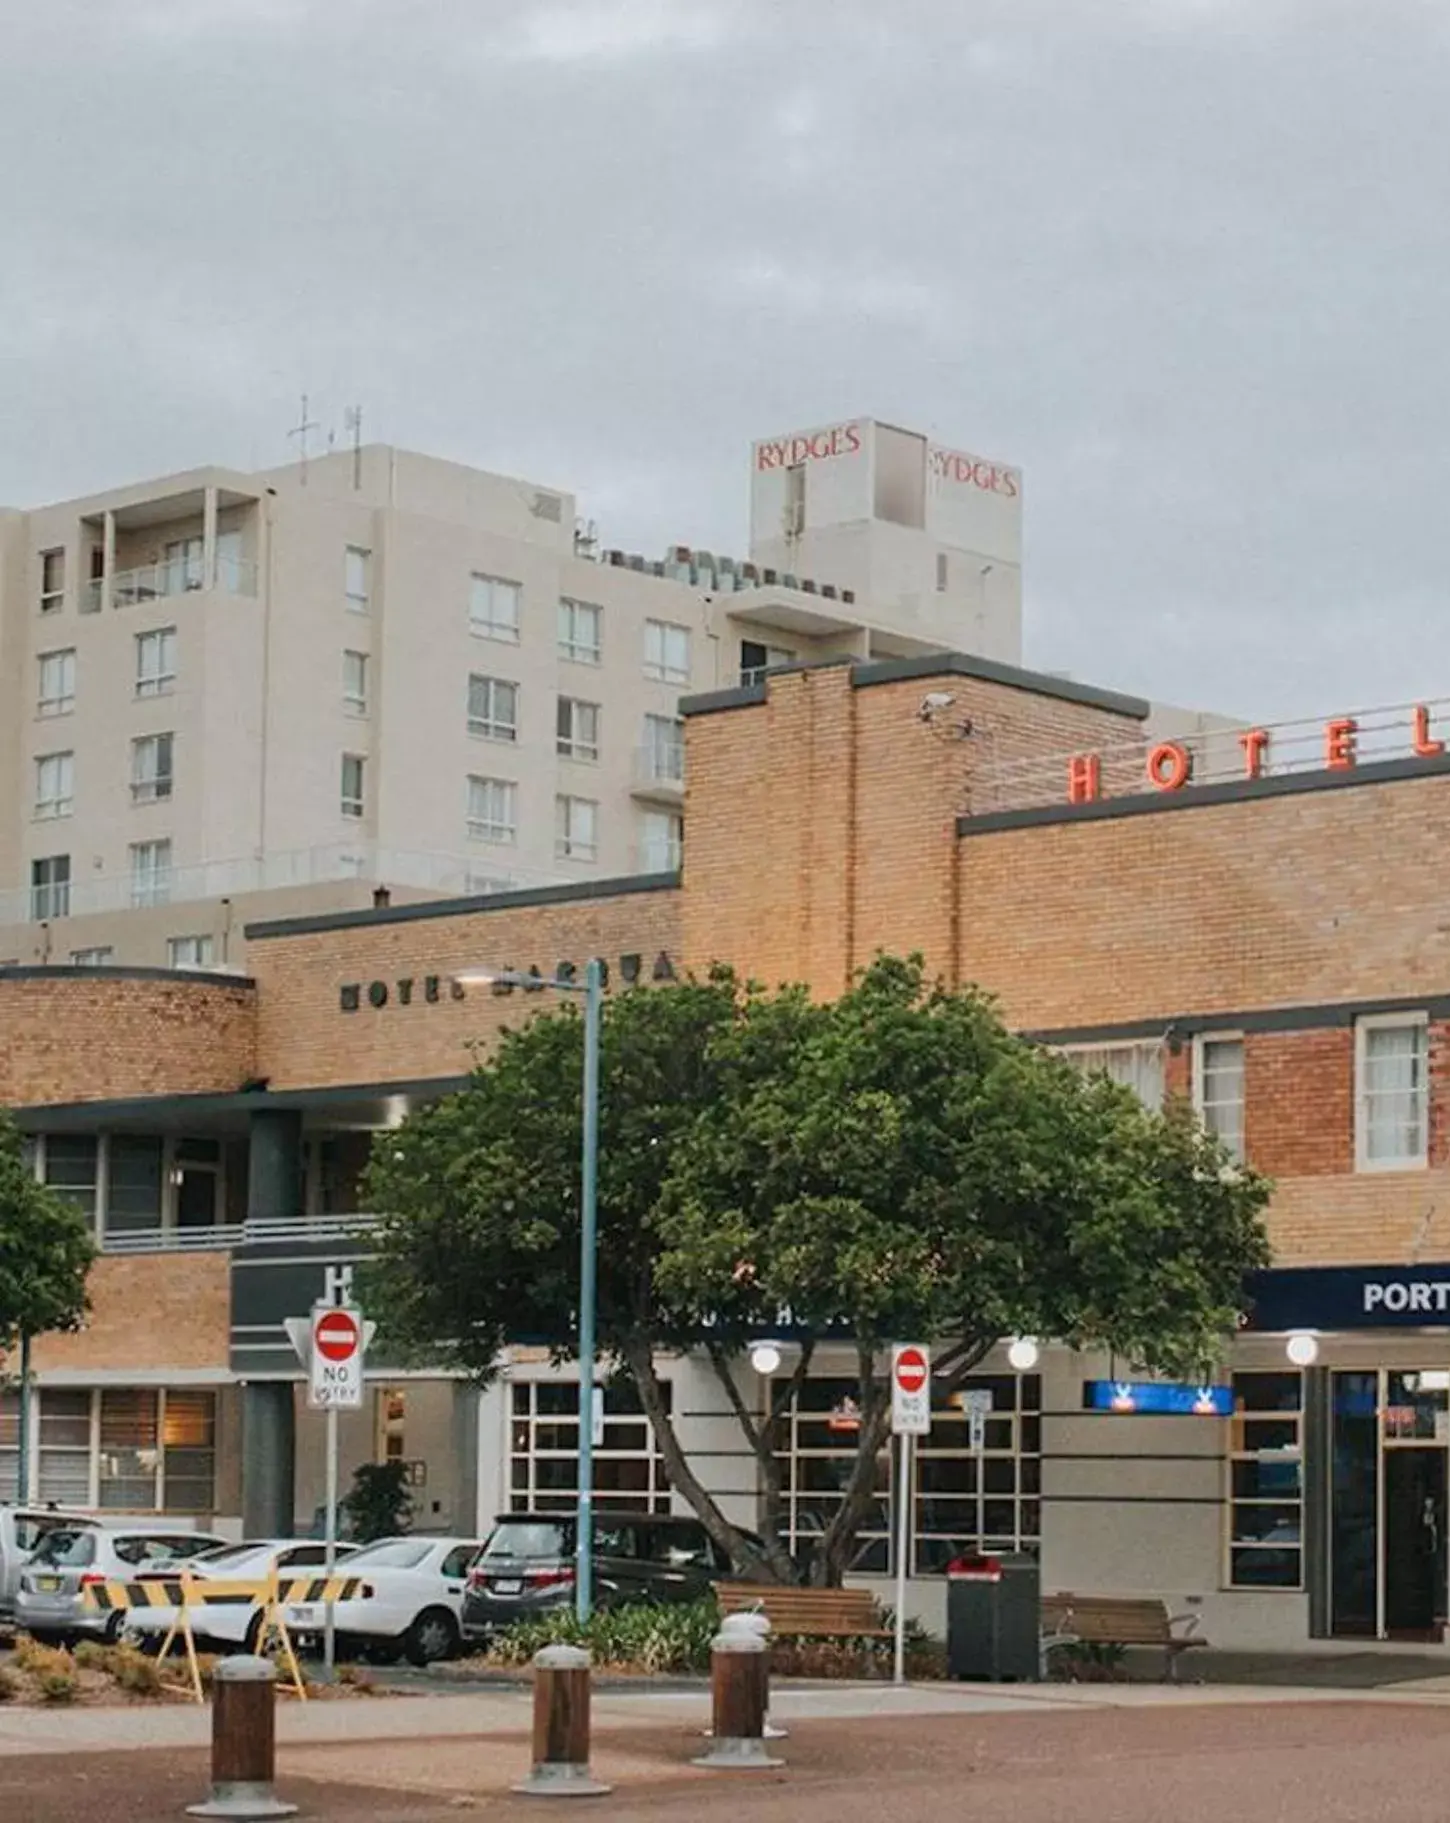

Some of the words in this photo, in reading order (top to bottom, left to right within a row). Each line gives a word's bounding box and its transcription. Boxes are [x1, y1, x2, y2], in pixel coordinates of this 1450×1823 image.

[757, 424, 861, 470] RYDGES
[1068, 705, 1445, 805] HOTEL
[340, 973, 466, 1012] HOTEL
[323, 1367, 349, 1384] NO
